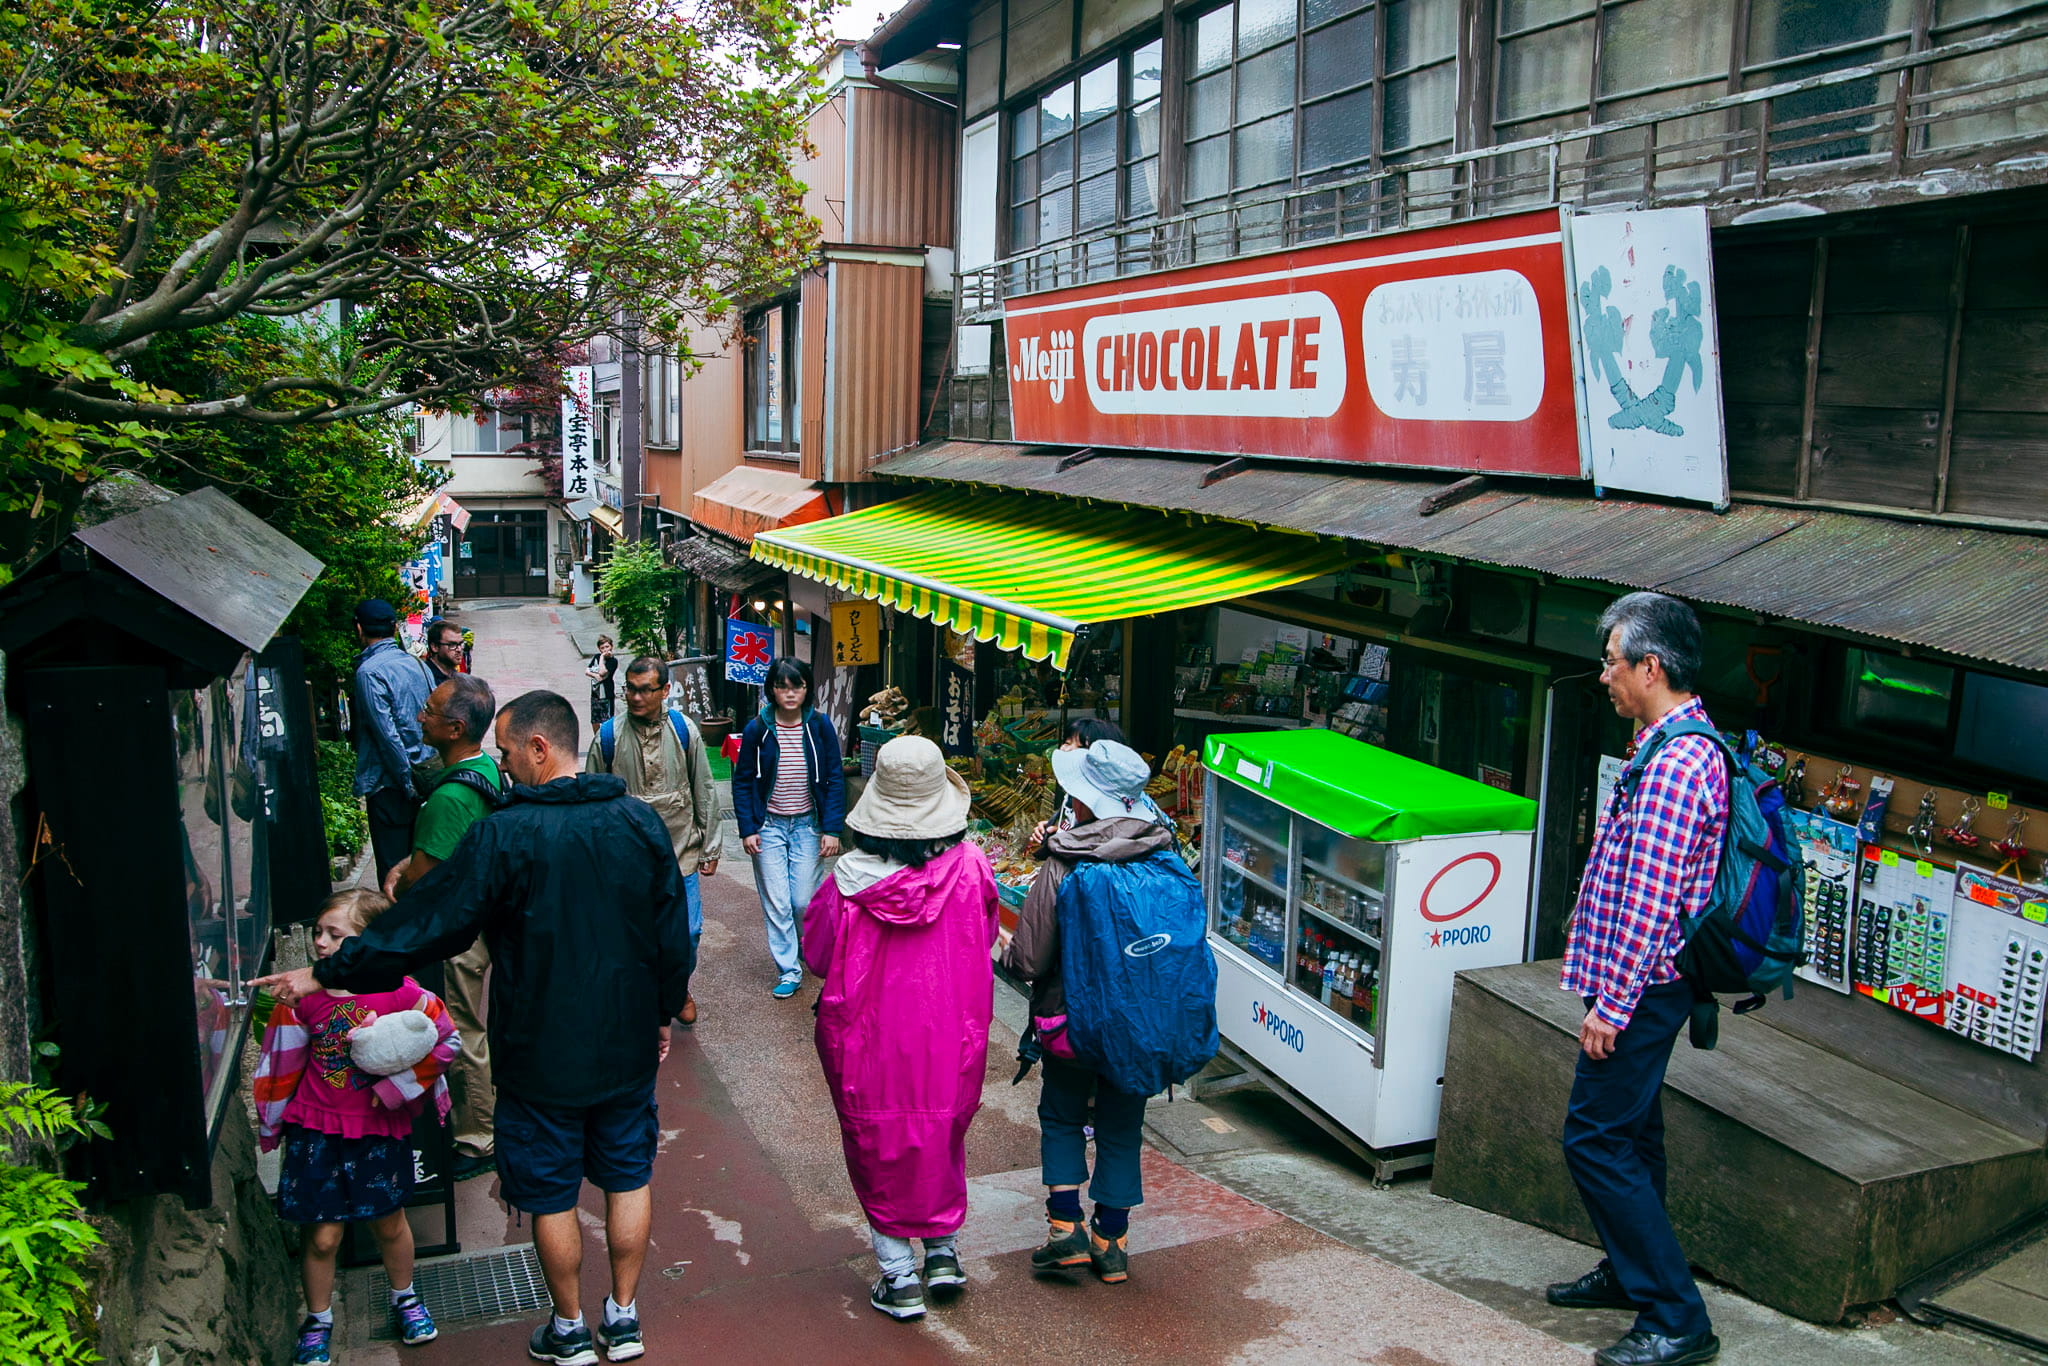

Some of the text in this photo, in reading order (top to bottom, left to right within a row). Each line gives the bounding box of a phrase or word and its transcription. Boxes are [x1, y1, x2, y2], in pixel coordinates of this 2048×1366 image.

[1013, 316, 1321, 404] Meiji CHOCOLATE
[729, 631, 771, 665] 氷
[849, 609, 863, 662] カレーうどん
[943, 671, 961, 746] おそば
